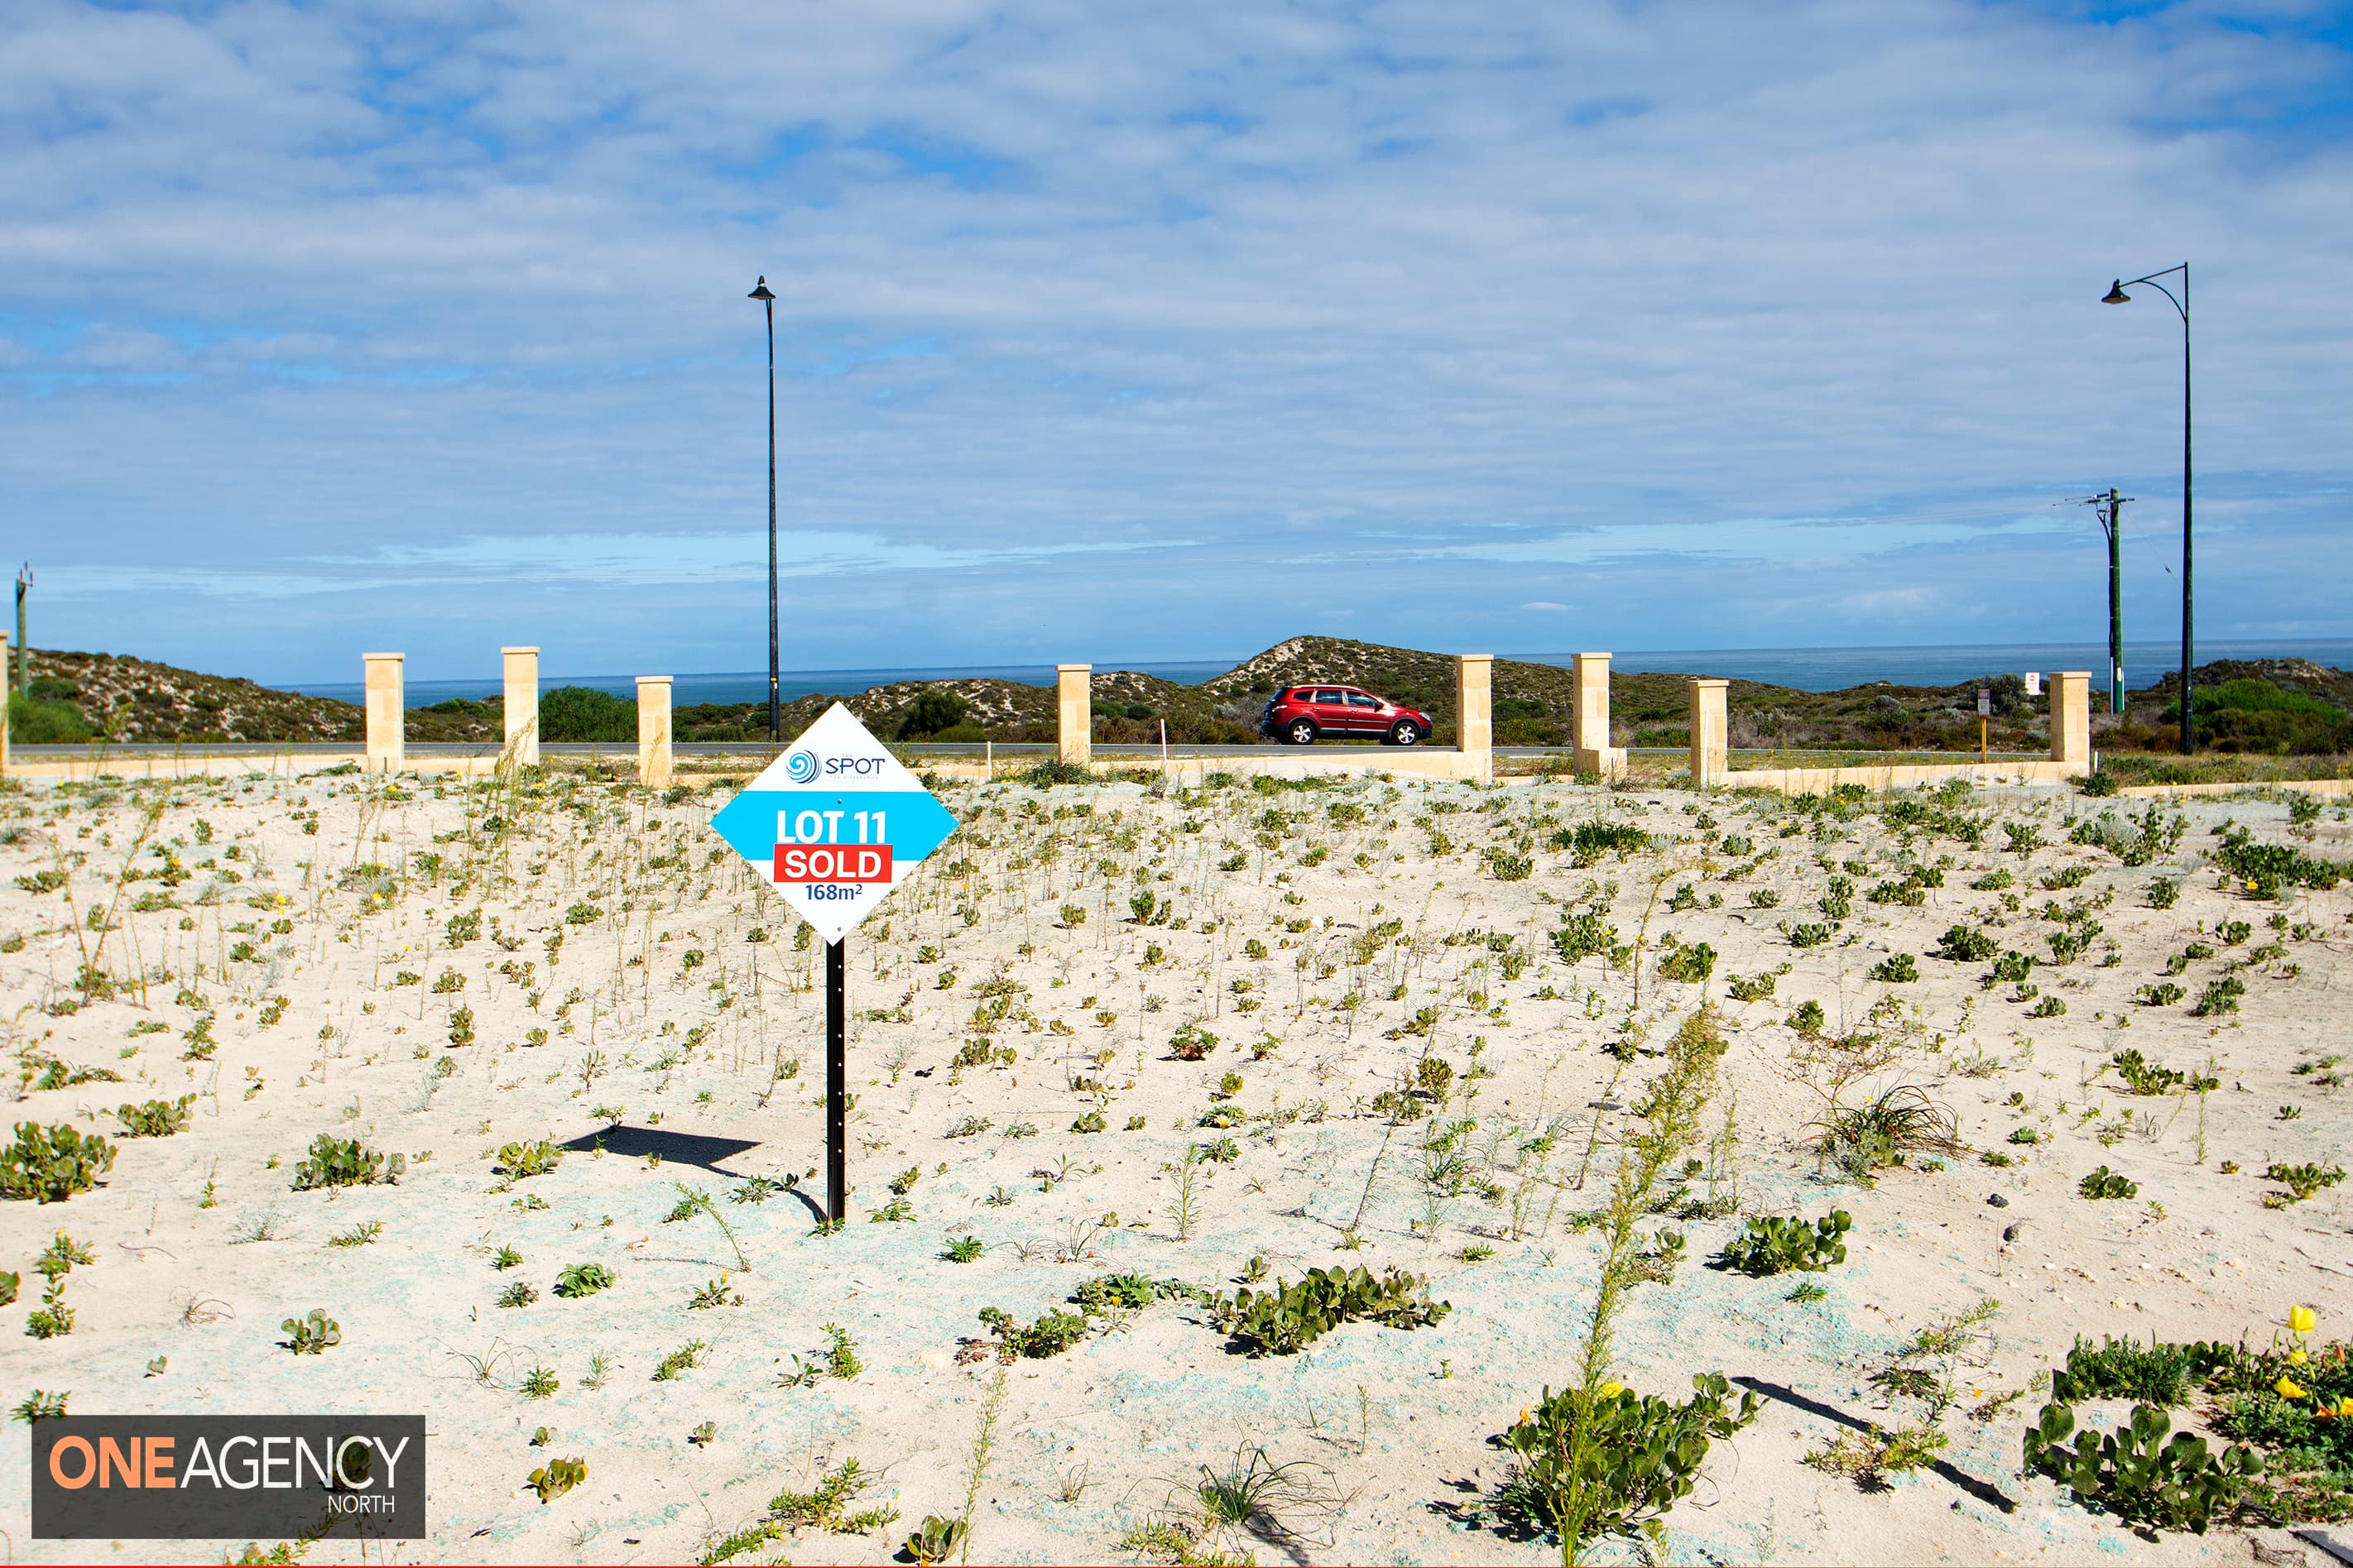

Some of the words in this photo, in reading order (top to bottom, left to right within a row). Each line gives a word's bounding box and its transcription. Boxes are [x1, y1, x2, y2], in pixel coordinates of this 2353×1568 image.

[825, 758, 886, 774] SPOT
[776, 810, 844, 844] LOT
[853, 810, 886, 844] 11
[785, 850, 881, 879] SOLD
